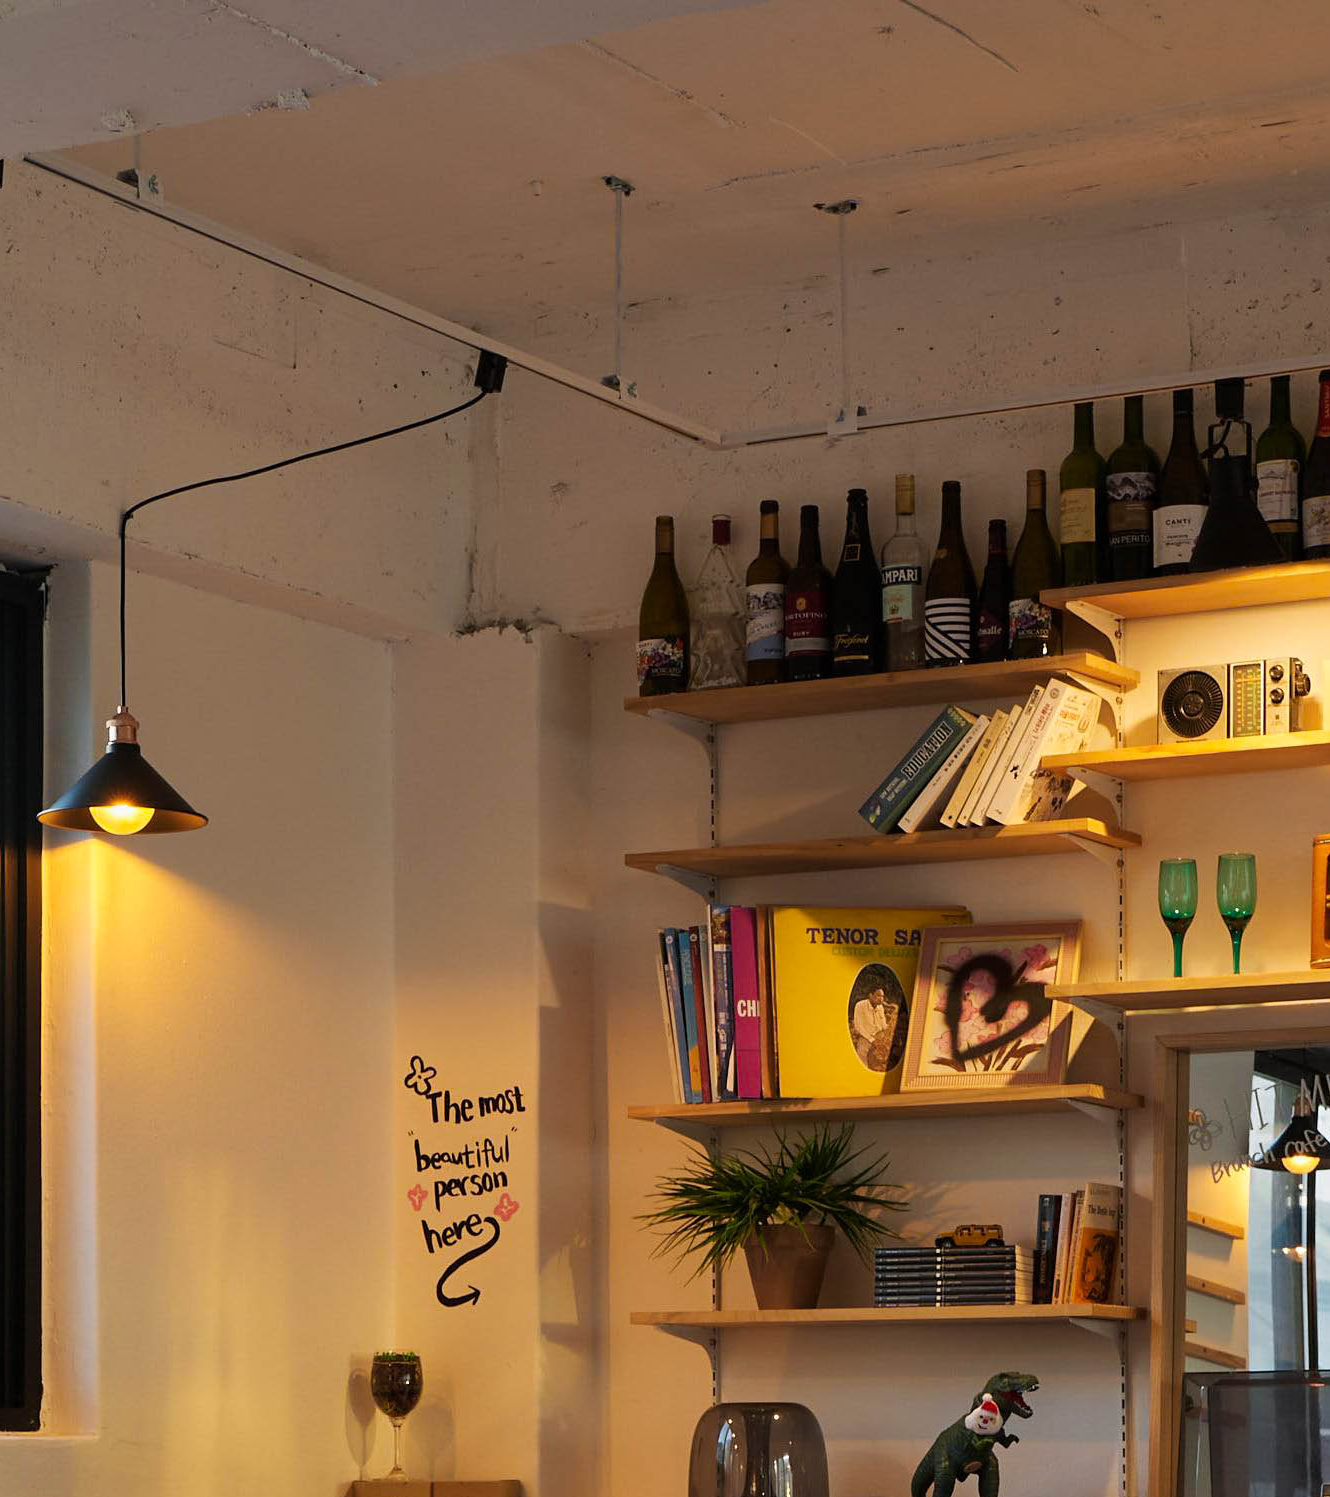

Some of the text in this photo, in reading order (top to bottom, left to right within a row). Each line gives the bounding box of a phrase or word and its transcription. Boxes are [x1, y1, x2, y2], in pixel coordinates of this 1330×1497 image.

[1165, 518, 1191, 526] CANTI
[881, 566, 918, 584] AMPARI
[900, 720, 954, 781] EDUCATION
[805, 927, 922, 945] TENOR SA
[425, 1085, 526, 1125] The most
[1284, 1128, 1328, 1158] cafe
[434, 1171, 508, 1211] person
[421, 1213, 485, 1254] here
